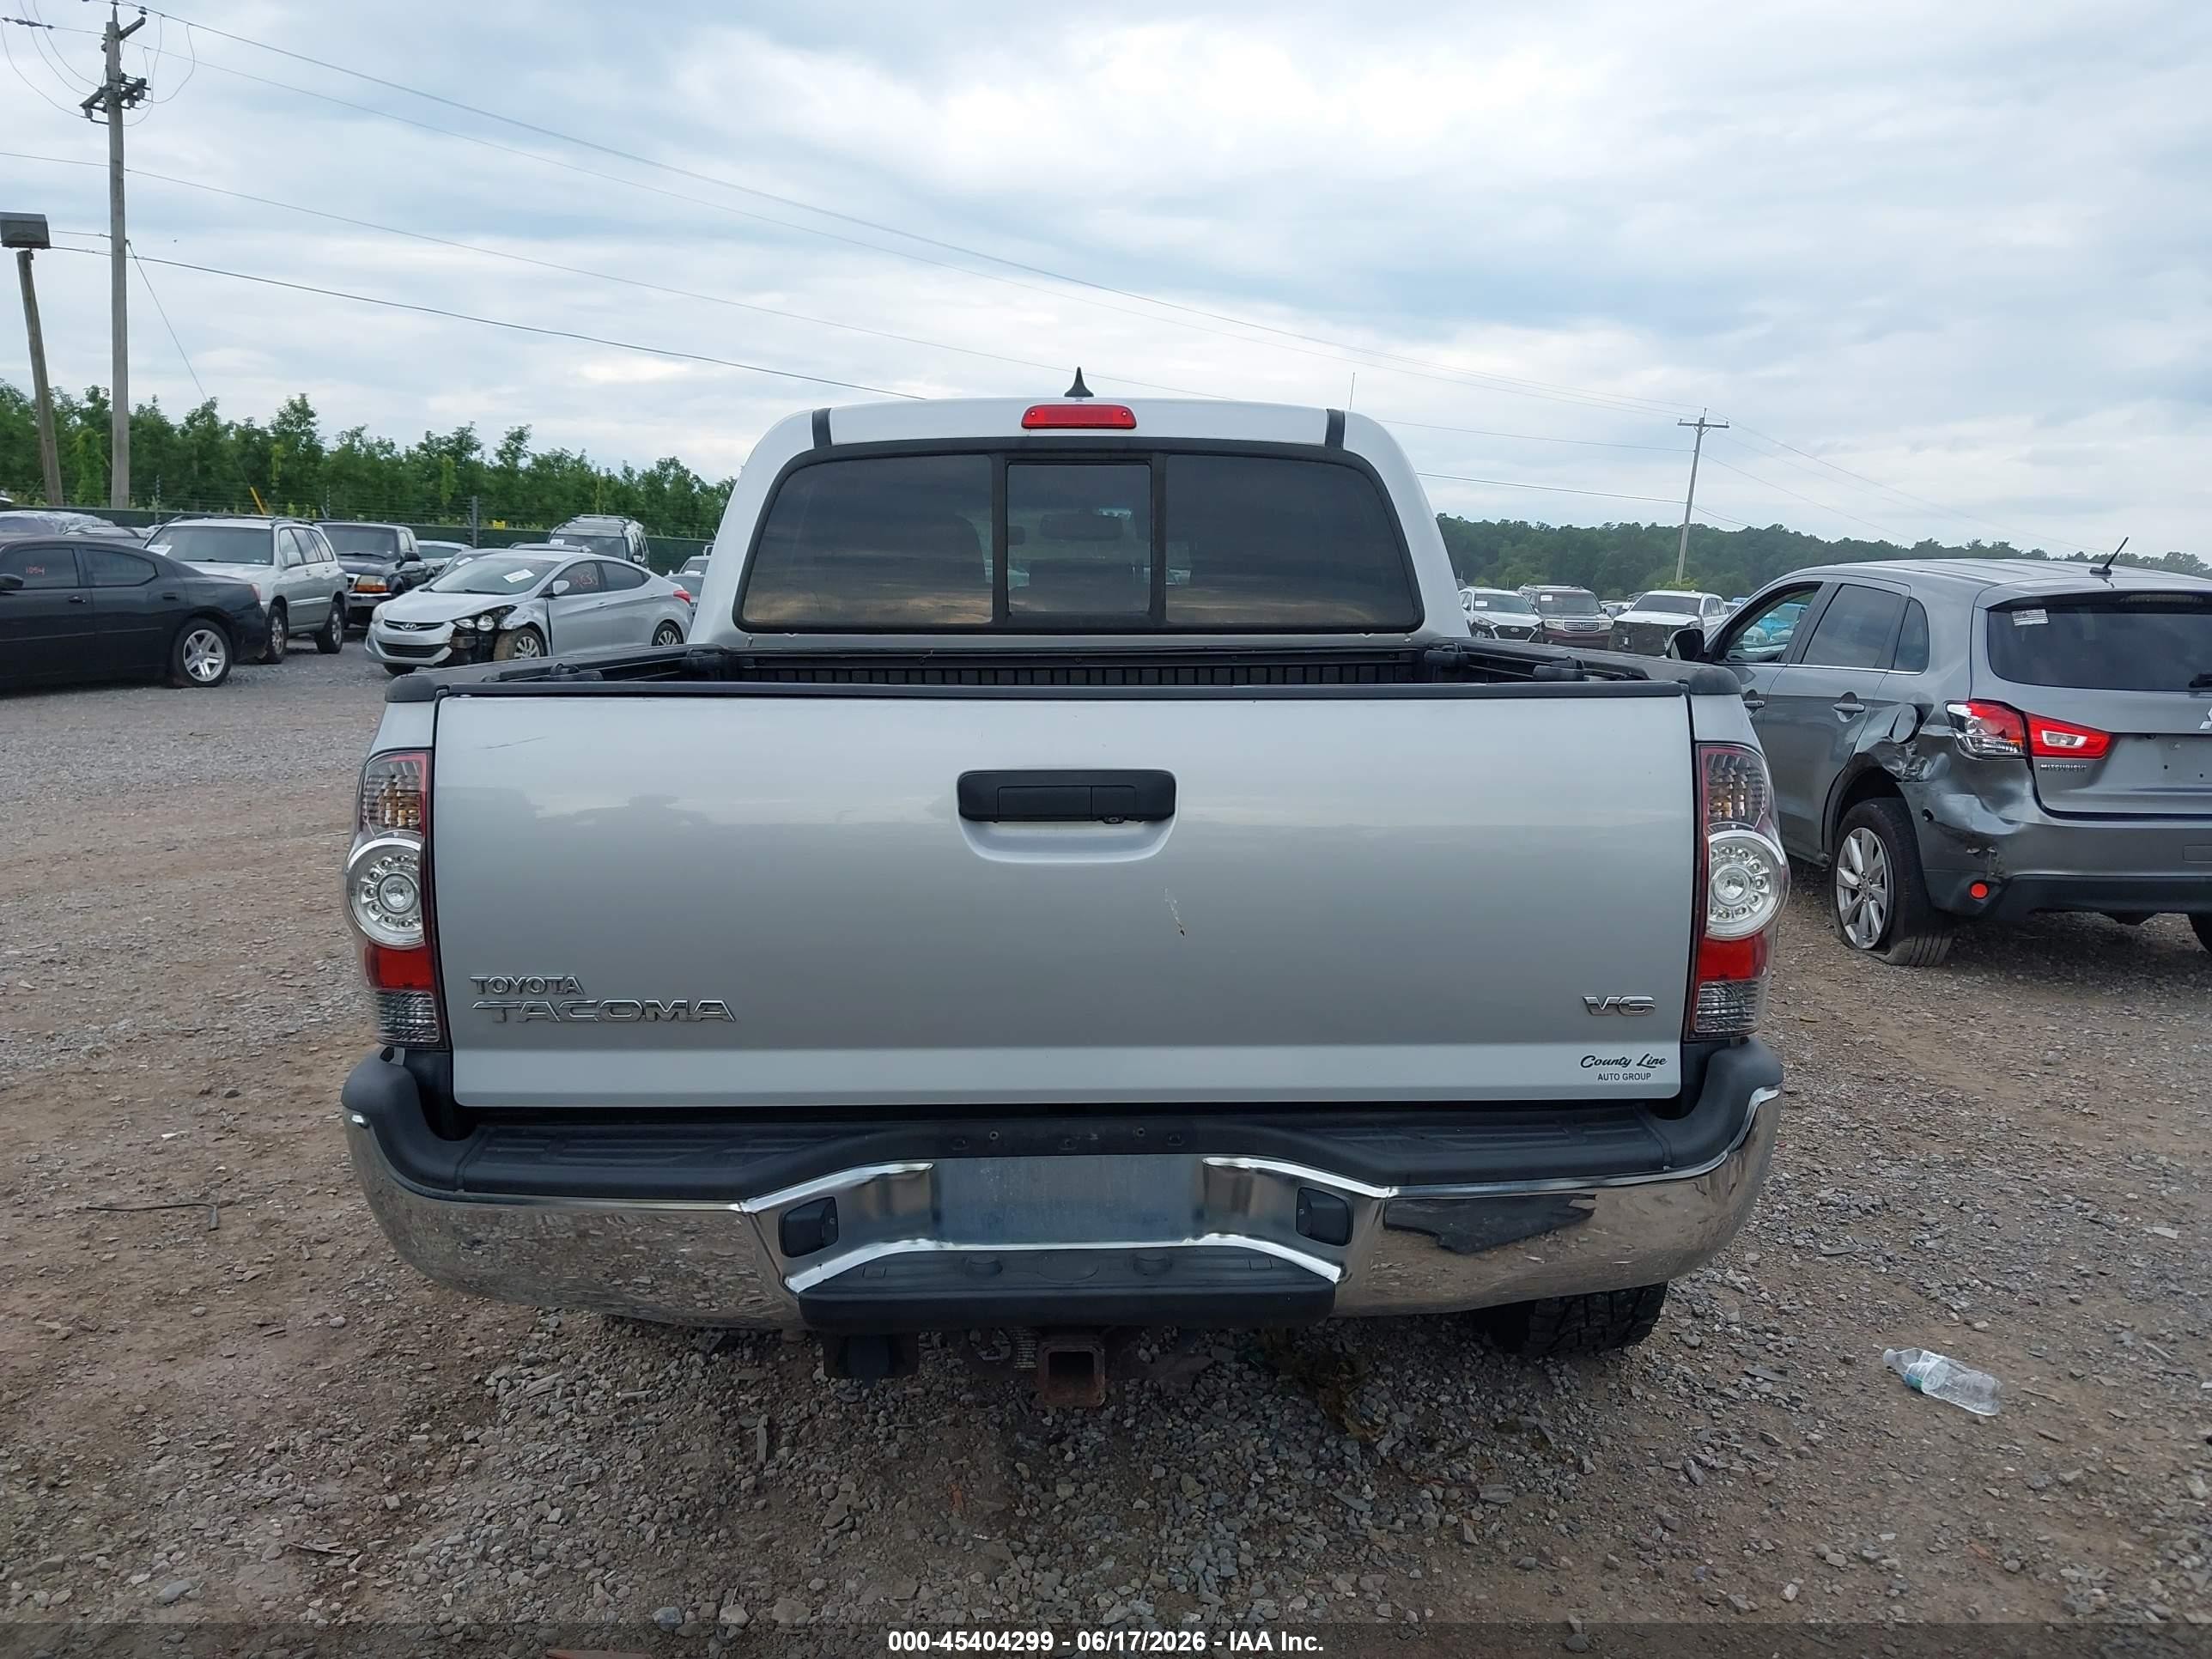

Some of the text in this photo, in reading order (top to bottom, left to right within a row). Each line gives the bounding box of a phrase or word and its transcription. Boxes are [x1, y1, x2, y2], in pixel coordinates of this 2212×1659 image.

[469, 975, 585, 995] TOYOTA
[472, 1000, 736, 1023] TACOMA
[1583, 995, 1656, 1016] V6
[1580, 1053, 1668, 1069] County Line
[1597, 1073, 1651, 1081] AUTO GROUP
